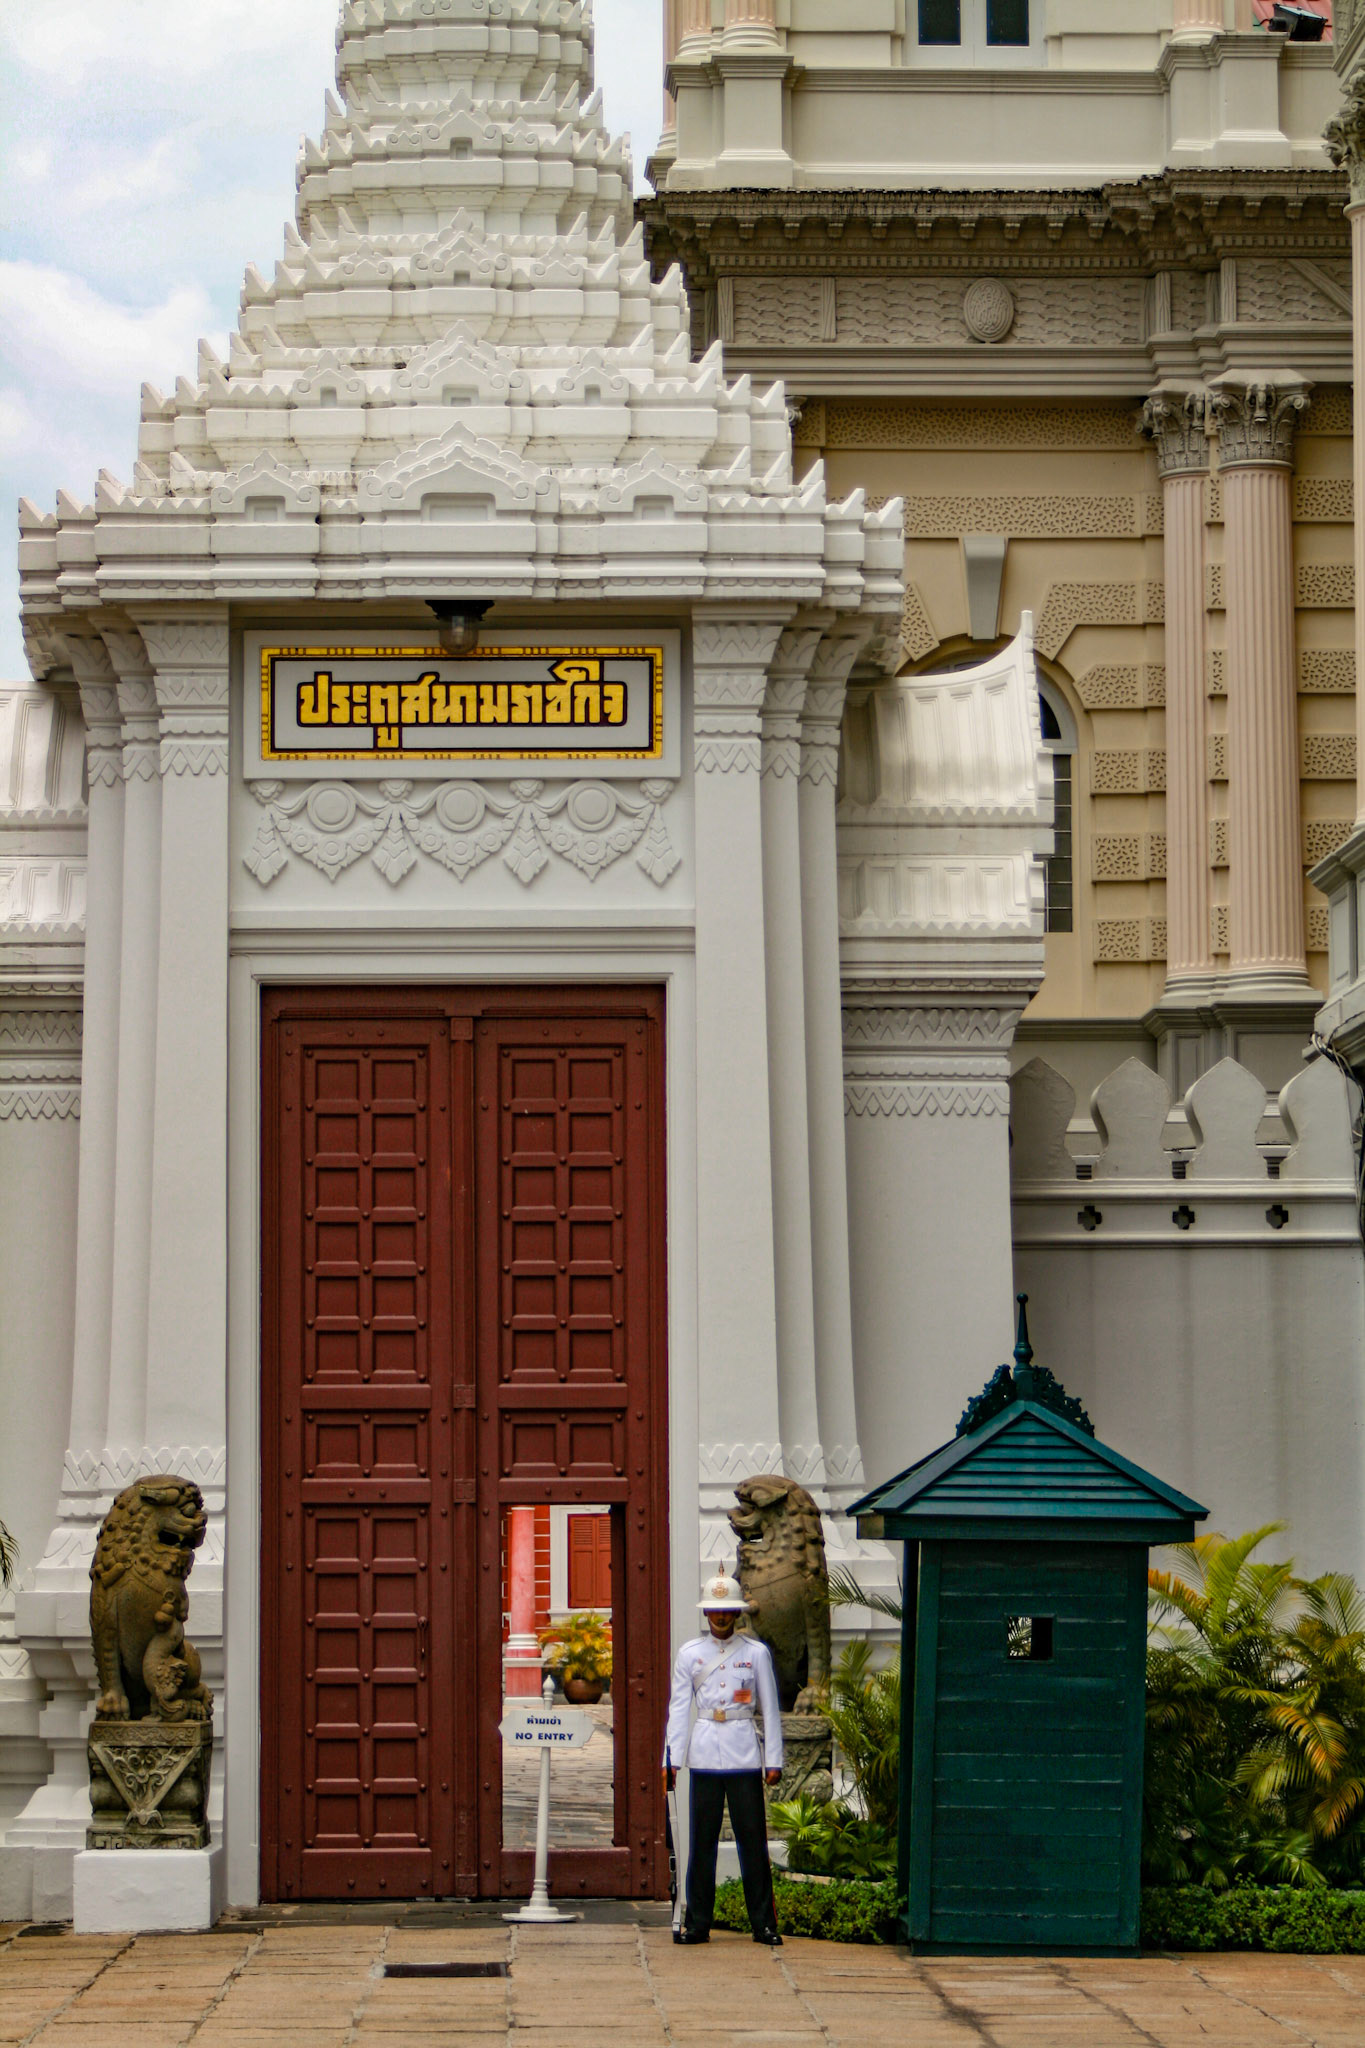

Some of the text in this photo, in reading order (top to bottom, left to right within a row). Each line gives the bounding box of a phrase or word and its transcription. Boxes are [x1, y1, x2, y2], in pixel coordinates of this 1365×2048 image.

[526, 1715, 562, 1726] ห้ามเข้า
[515, 1732, 574, 1741] NO ENTRY
